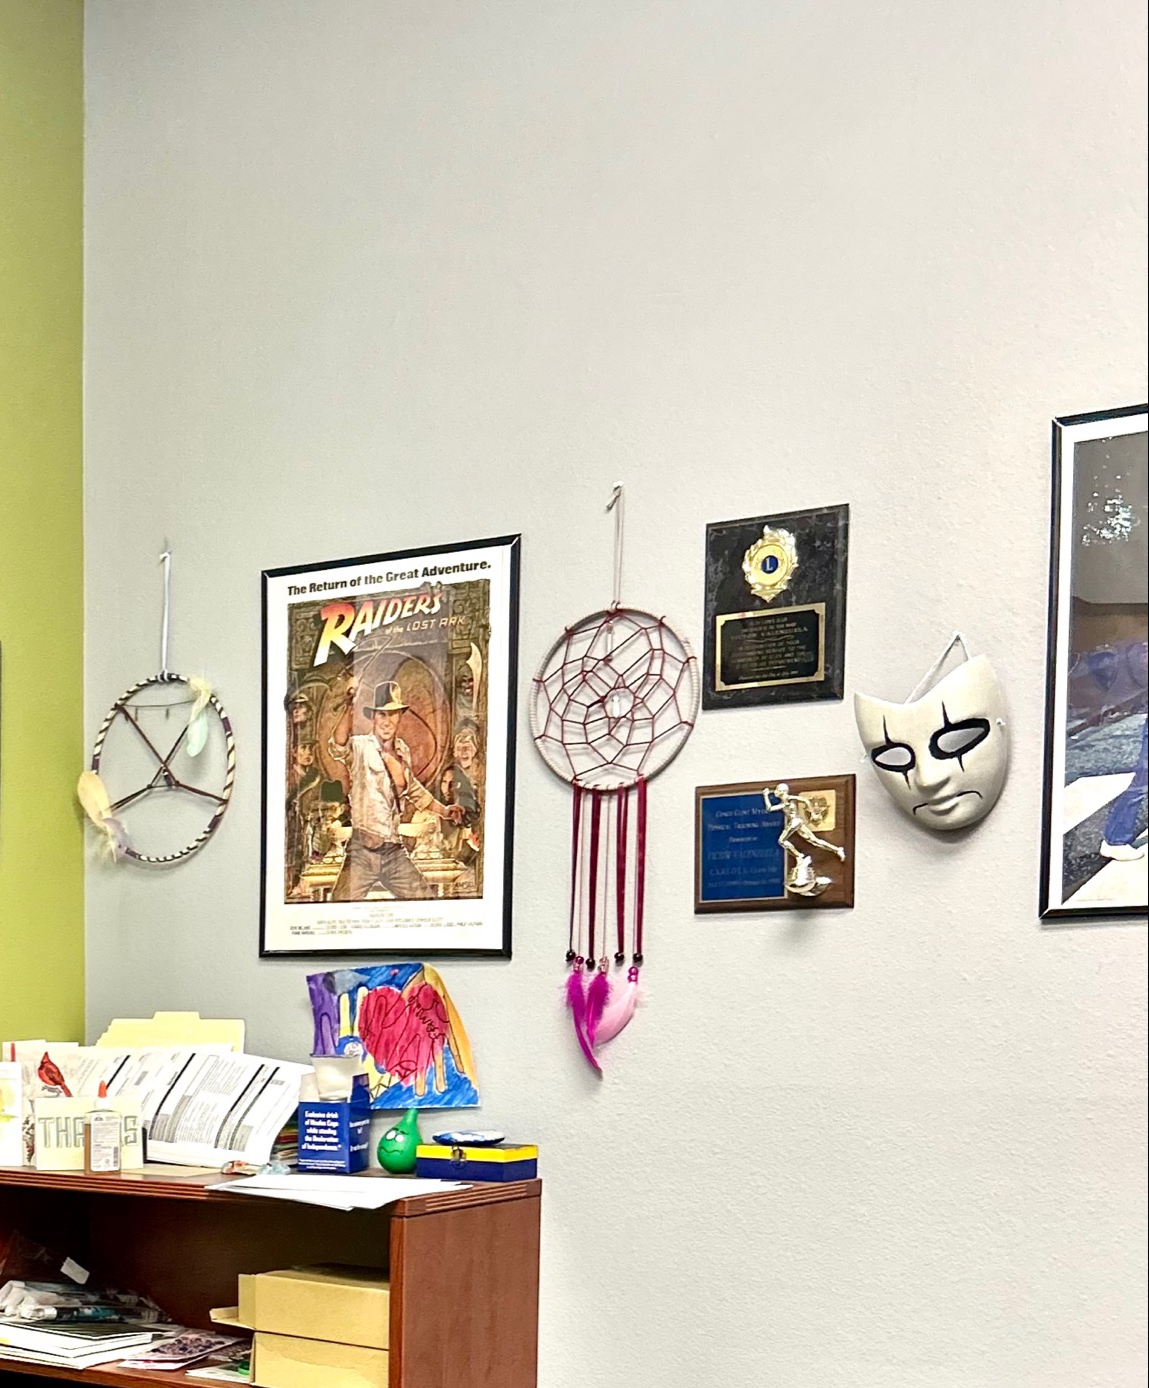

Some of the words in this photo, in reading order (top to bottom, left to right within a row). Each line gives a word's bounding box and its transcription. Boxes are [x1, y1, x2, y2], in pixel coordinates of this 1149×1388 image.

[287, 585, 307, 596] The
[309, 579, 348, 593] Return
[349, 577, 362, 587] of
[364, 574, 384, 585] the
[386, 568, 419, 583] Great
[421, 560, 492, 578] Adventure.
[766, 557, 774, 572] L
[313, 591, 444, 667] RAIDERS
[406, 618, 437, 632] LOST
[438, 615, 466, 628] ARK
[38, 1116, 139, 1148] THAS
